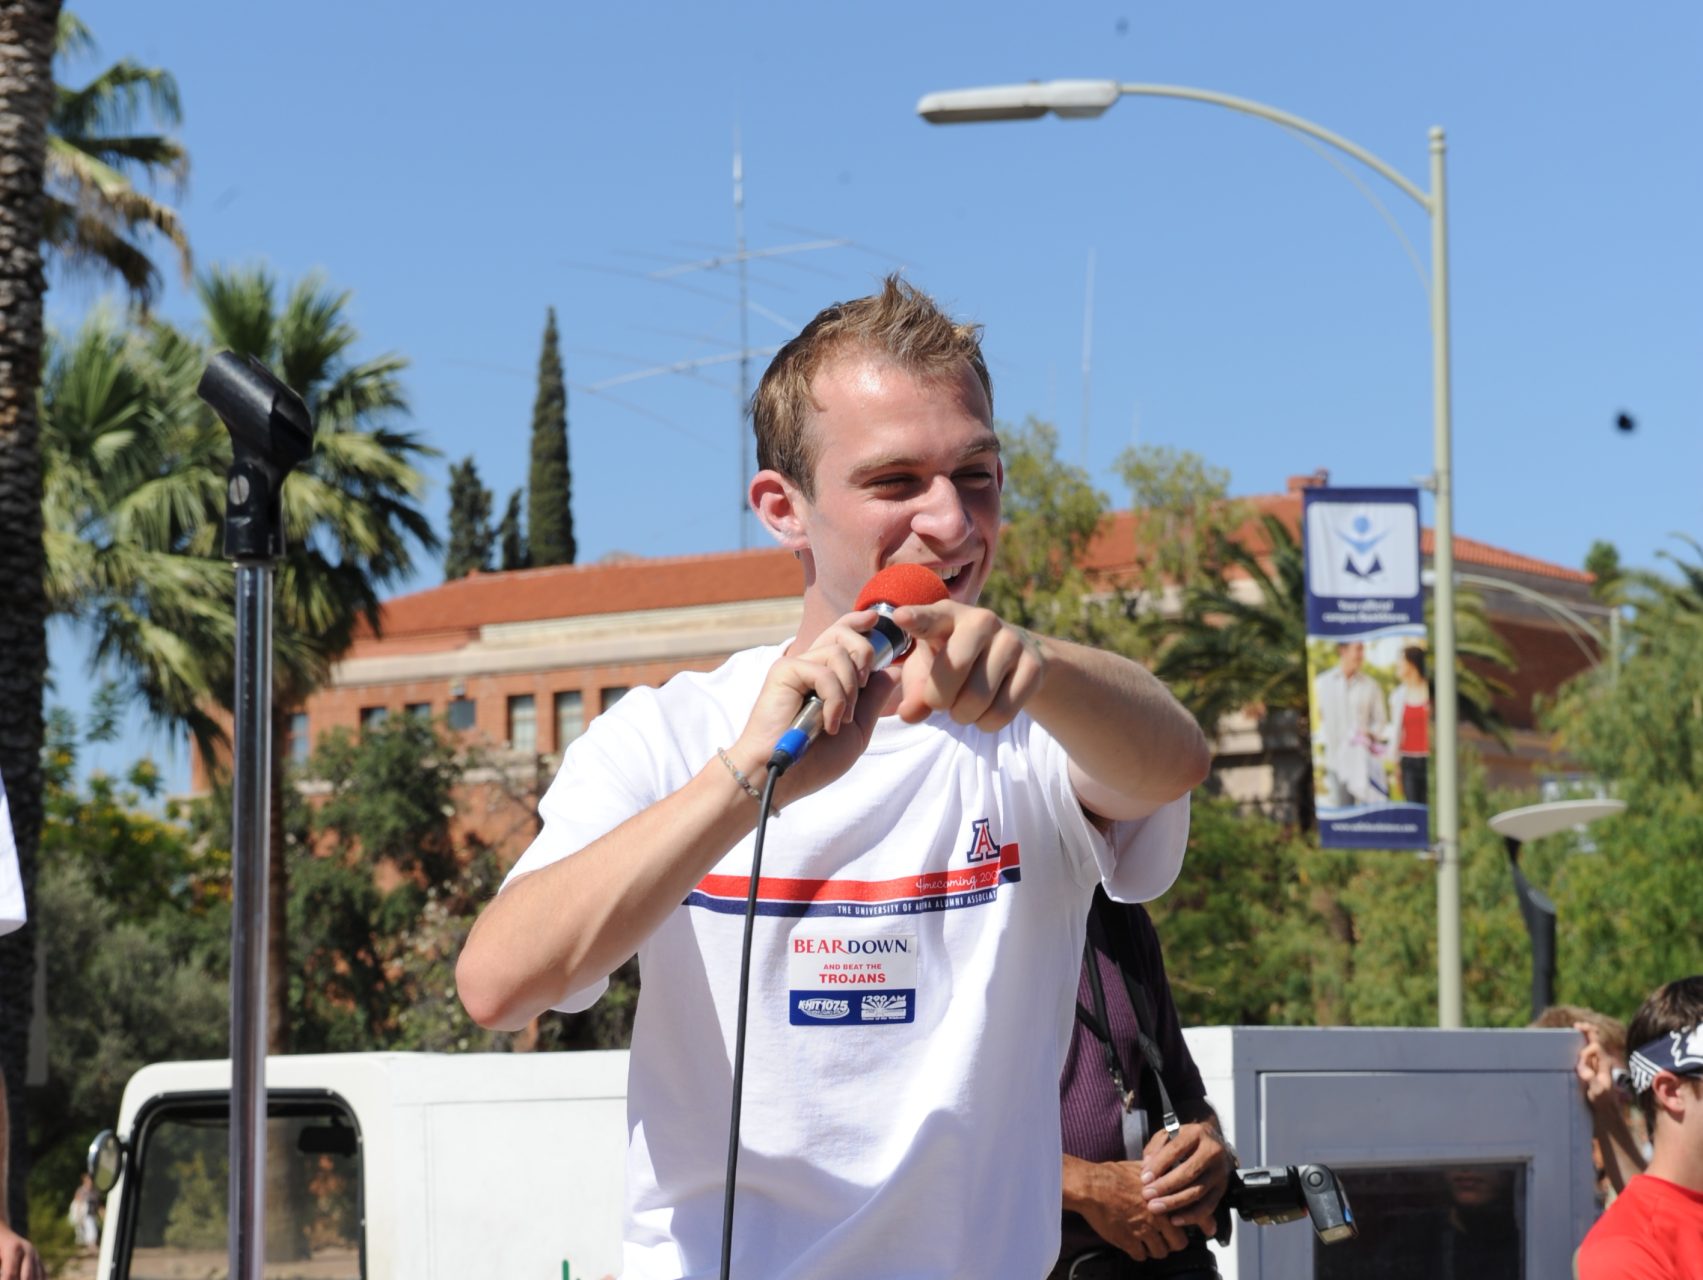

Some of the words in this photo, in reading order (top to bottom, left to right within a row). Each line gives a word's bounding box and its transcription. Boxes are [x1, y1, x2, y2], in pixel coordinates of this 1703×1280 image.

[967, 818, 1000, 863] A
[837, 905, 852, 914] THE
[855, 904, 899, 915] UNIVERSITY
[902, 902, 912, 912] OF
[935, 897, 964, 909] ALUMNI
[819, 973, 886, 984] TROJANS
